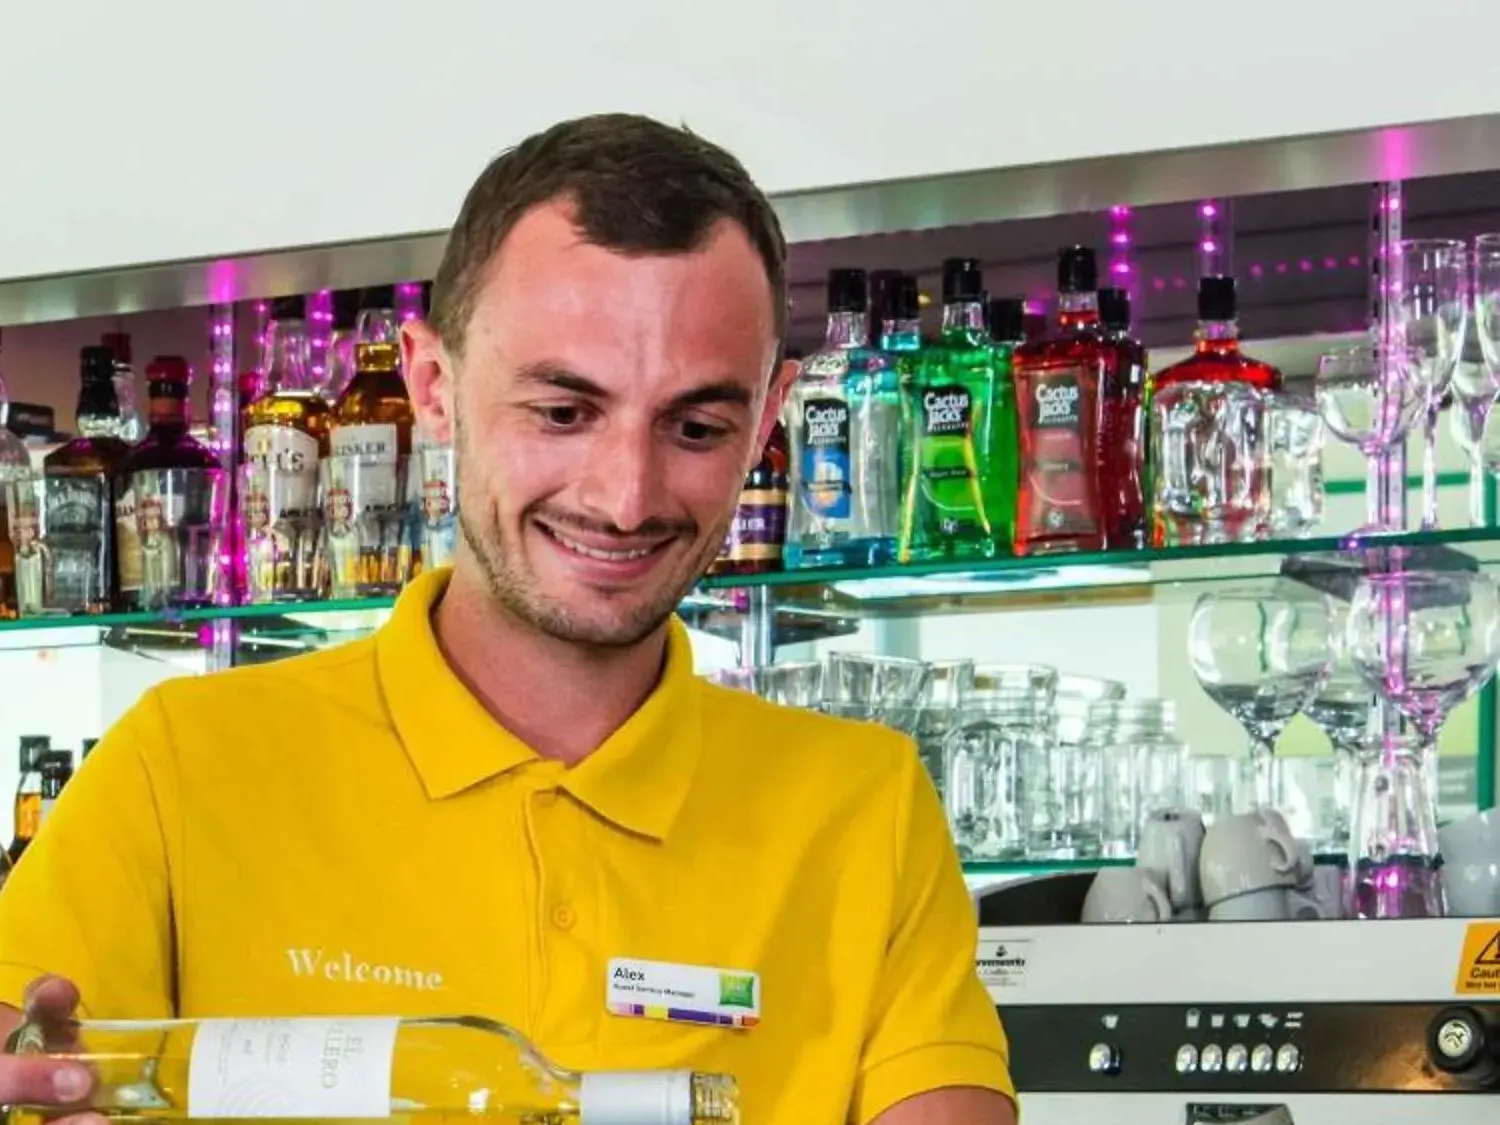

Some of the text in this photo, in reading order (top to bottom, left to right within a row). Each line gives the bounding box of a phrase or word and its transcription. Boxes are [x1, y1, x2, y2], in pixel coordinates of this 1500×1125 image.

[923, 391, 969, 409] Cactus
[1035, 383, 1079, 401] Cactus
[805, 406, 847, 424] Cactus
[286, 947, 444, 991] Welcome
[613, 966, 646, 982] Alex
